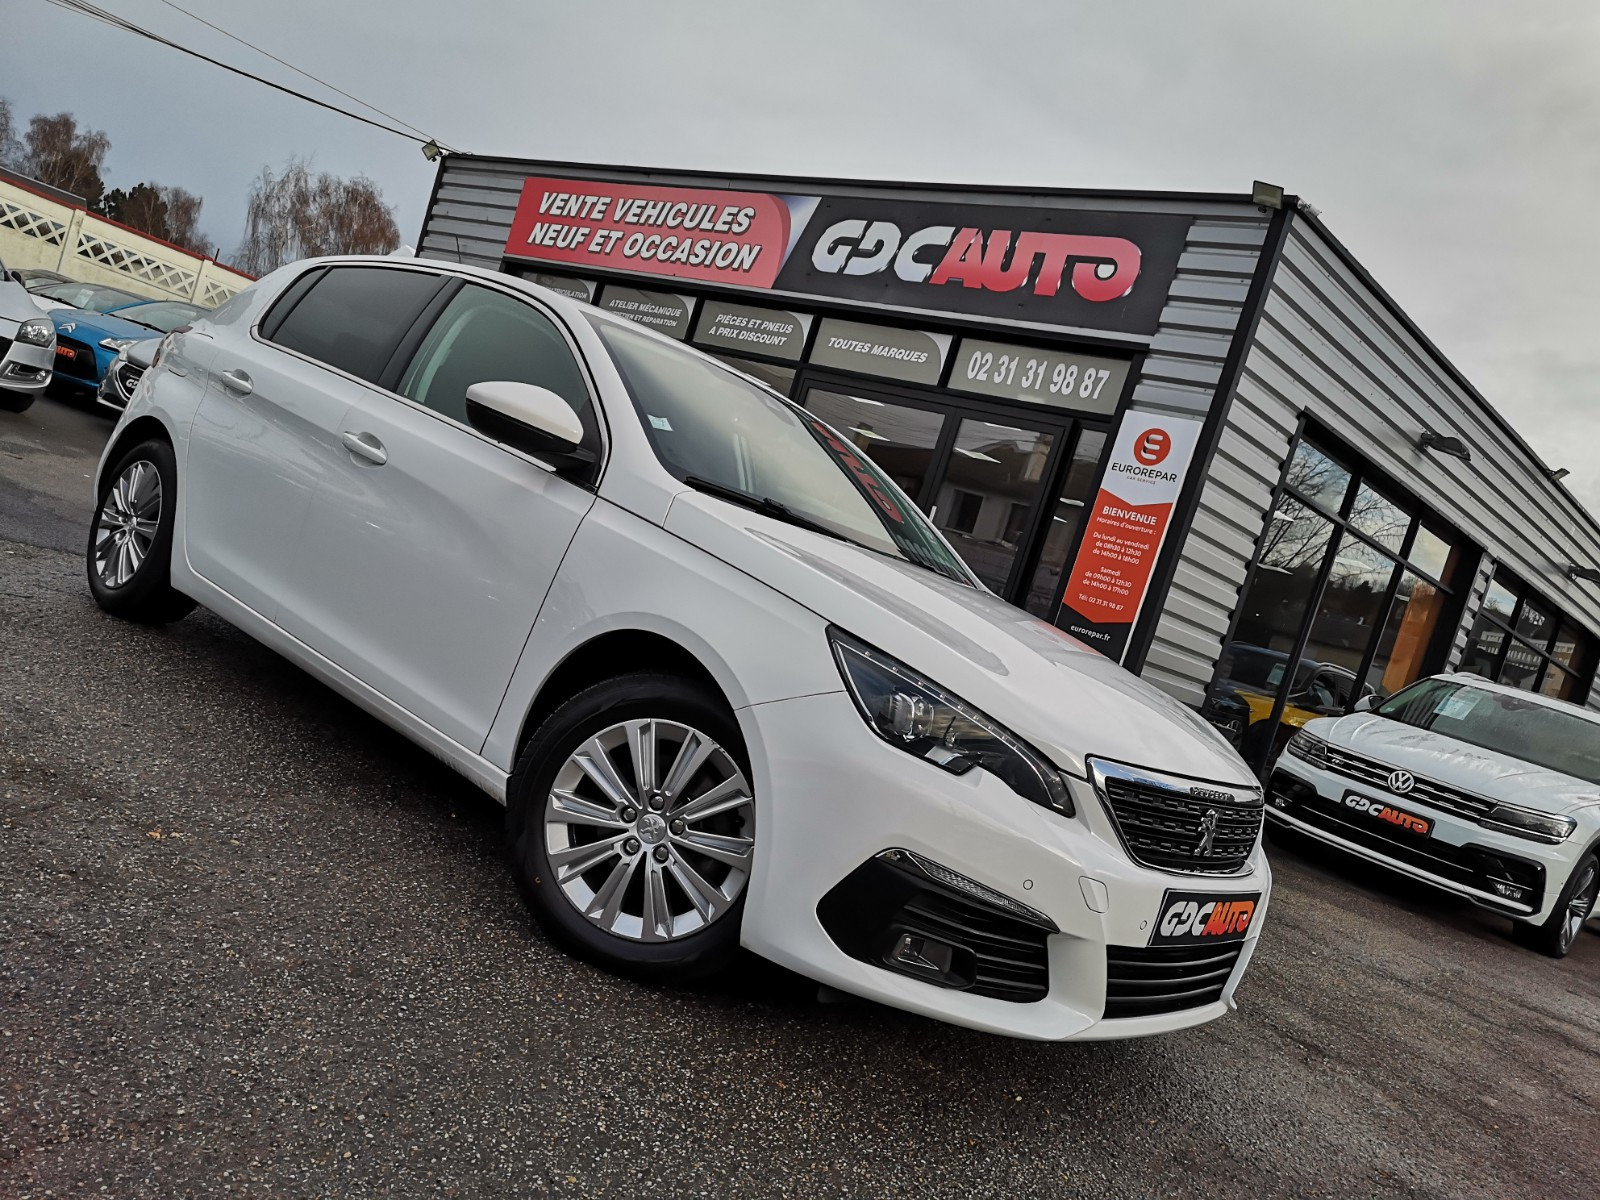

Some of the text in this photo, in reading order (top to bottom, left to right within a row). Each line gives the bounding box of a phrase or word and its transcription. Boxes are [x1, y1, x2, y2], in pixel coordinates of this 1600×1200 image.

[539, 192, 755, 233] VENTE VEHICULES
[527, 222, 762, 271] NEUF ET OCCASION
[608, 299, 683, 317] ATELIER MÉCANIQUE
[633, 314, 643, 322] ET
[642, 315, 678, 327] RÉPARATION
[715, 313, 794, 335] PIÈCES ET PNEUS
[708, 327, 788, 347] A PRIX DISCOUNT
[828, 337, 929, 363] TOUTES MARQUES
[967, 350, 1111, 400] 02 31 31 98 87
[1111, 462, 1178, 483] EUROREPAR
[1102, 505, 1158, 525] BIENVENUE
[1096, 516, 1119, 527] Horaires
[1120, 522, 1153, 535] d'ouverture
[1102, 533, 1116, 542] lundi
[1124, 539, 1150, 550] vendredi
[1100, 566, 1121, 577] Samedi
[1082, 578, 1091, 586] de
[1070, 625, 1111, 641] eurorepar.fr
